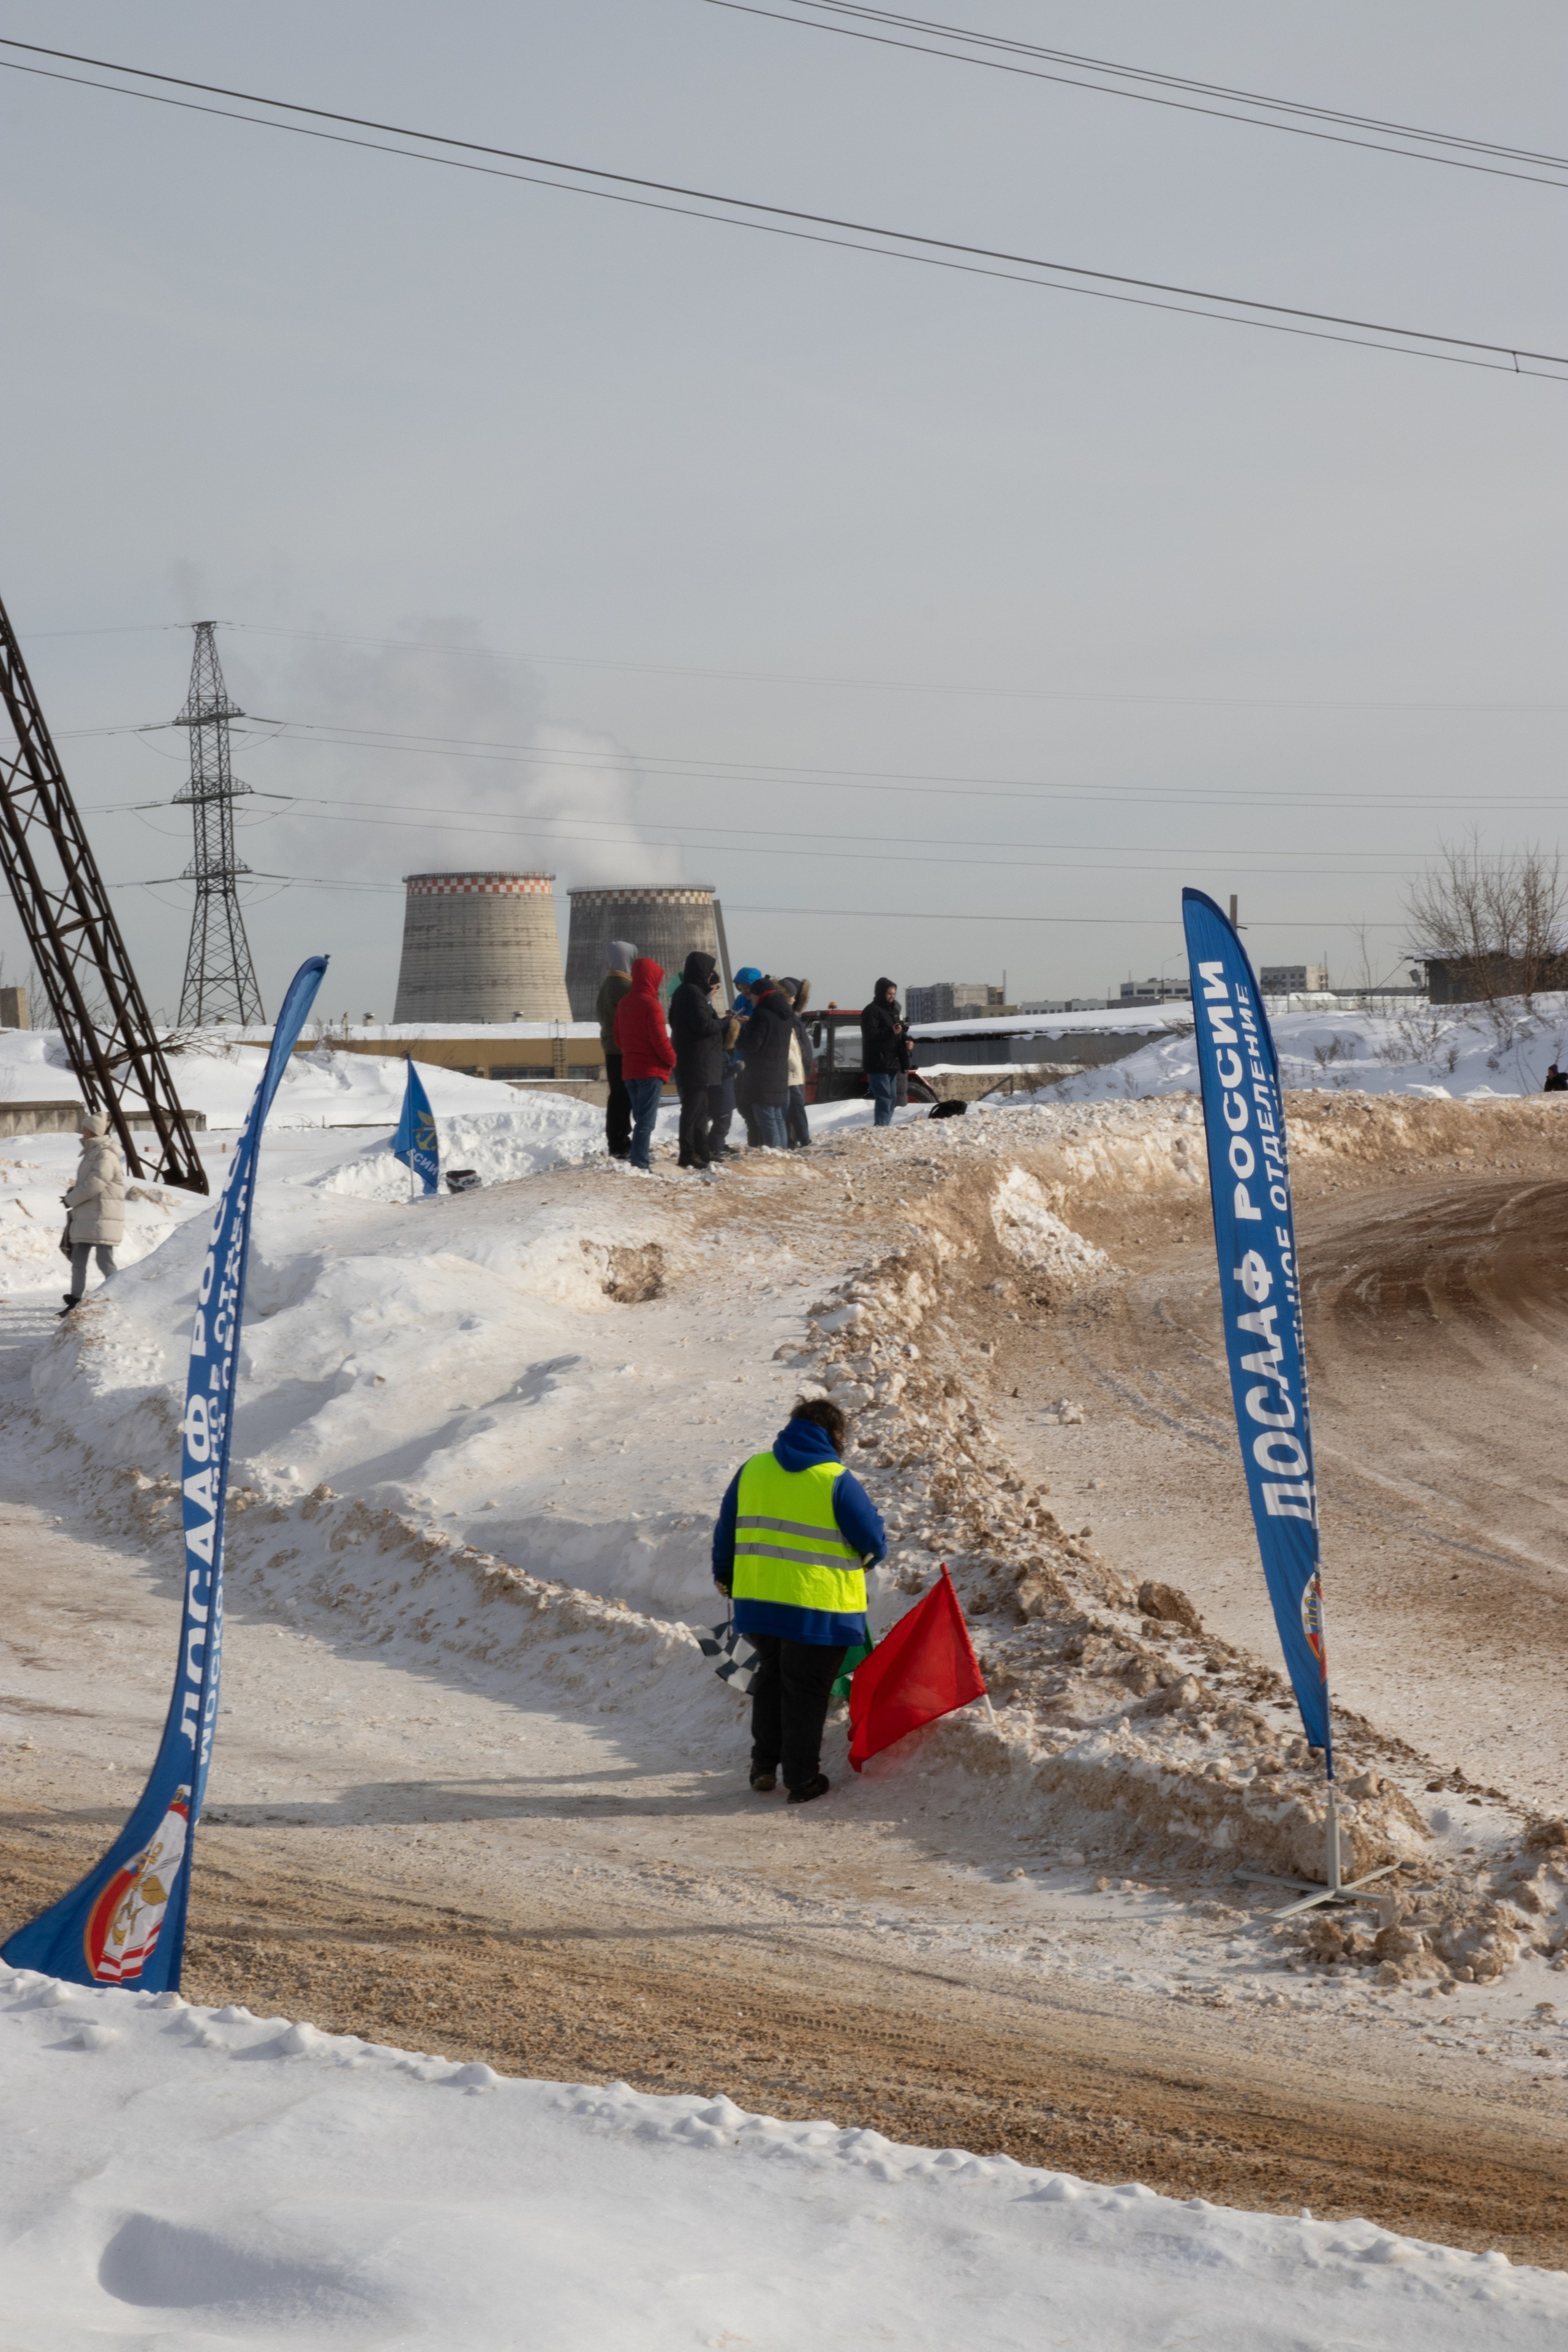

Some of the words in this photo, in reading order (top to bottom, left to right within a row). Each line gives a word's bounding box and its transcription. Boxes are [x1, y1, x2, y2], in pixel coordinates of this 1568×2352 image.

[1198, 962, 1262, 1220] РОССИИ
[1235, 983, 1287, 1212] ОТДЕЛЕНИЕ
[1234, 1250, 1316, 1525] ДОСААФ
